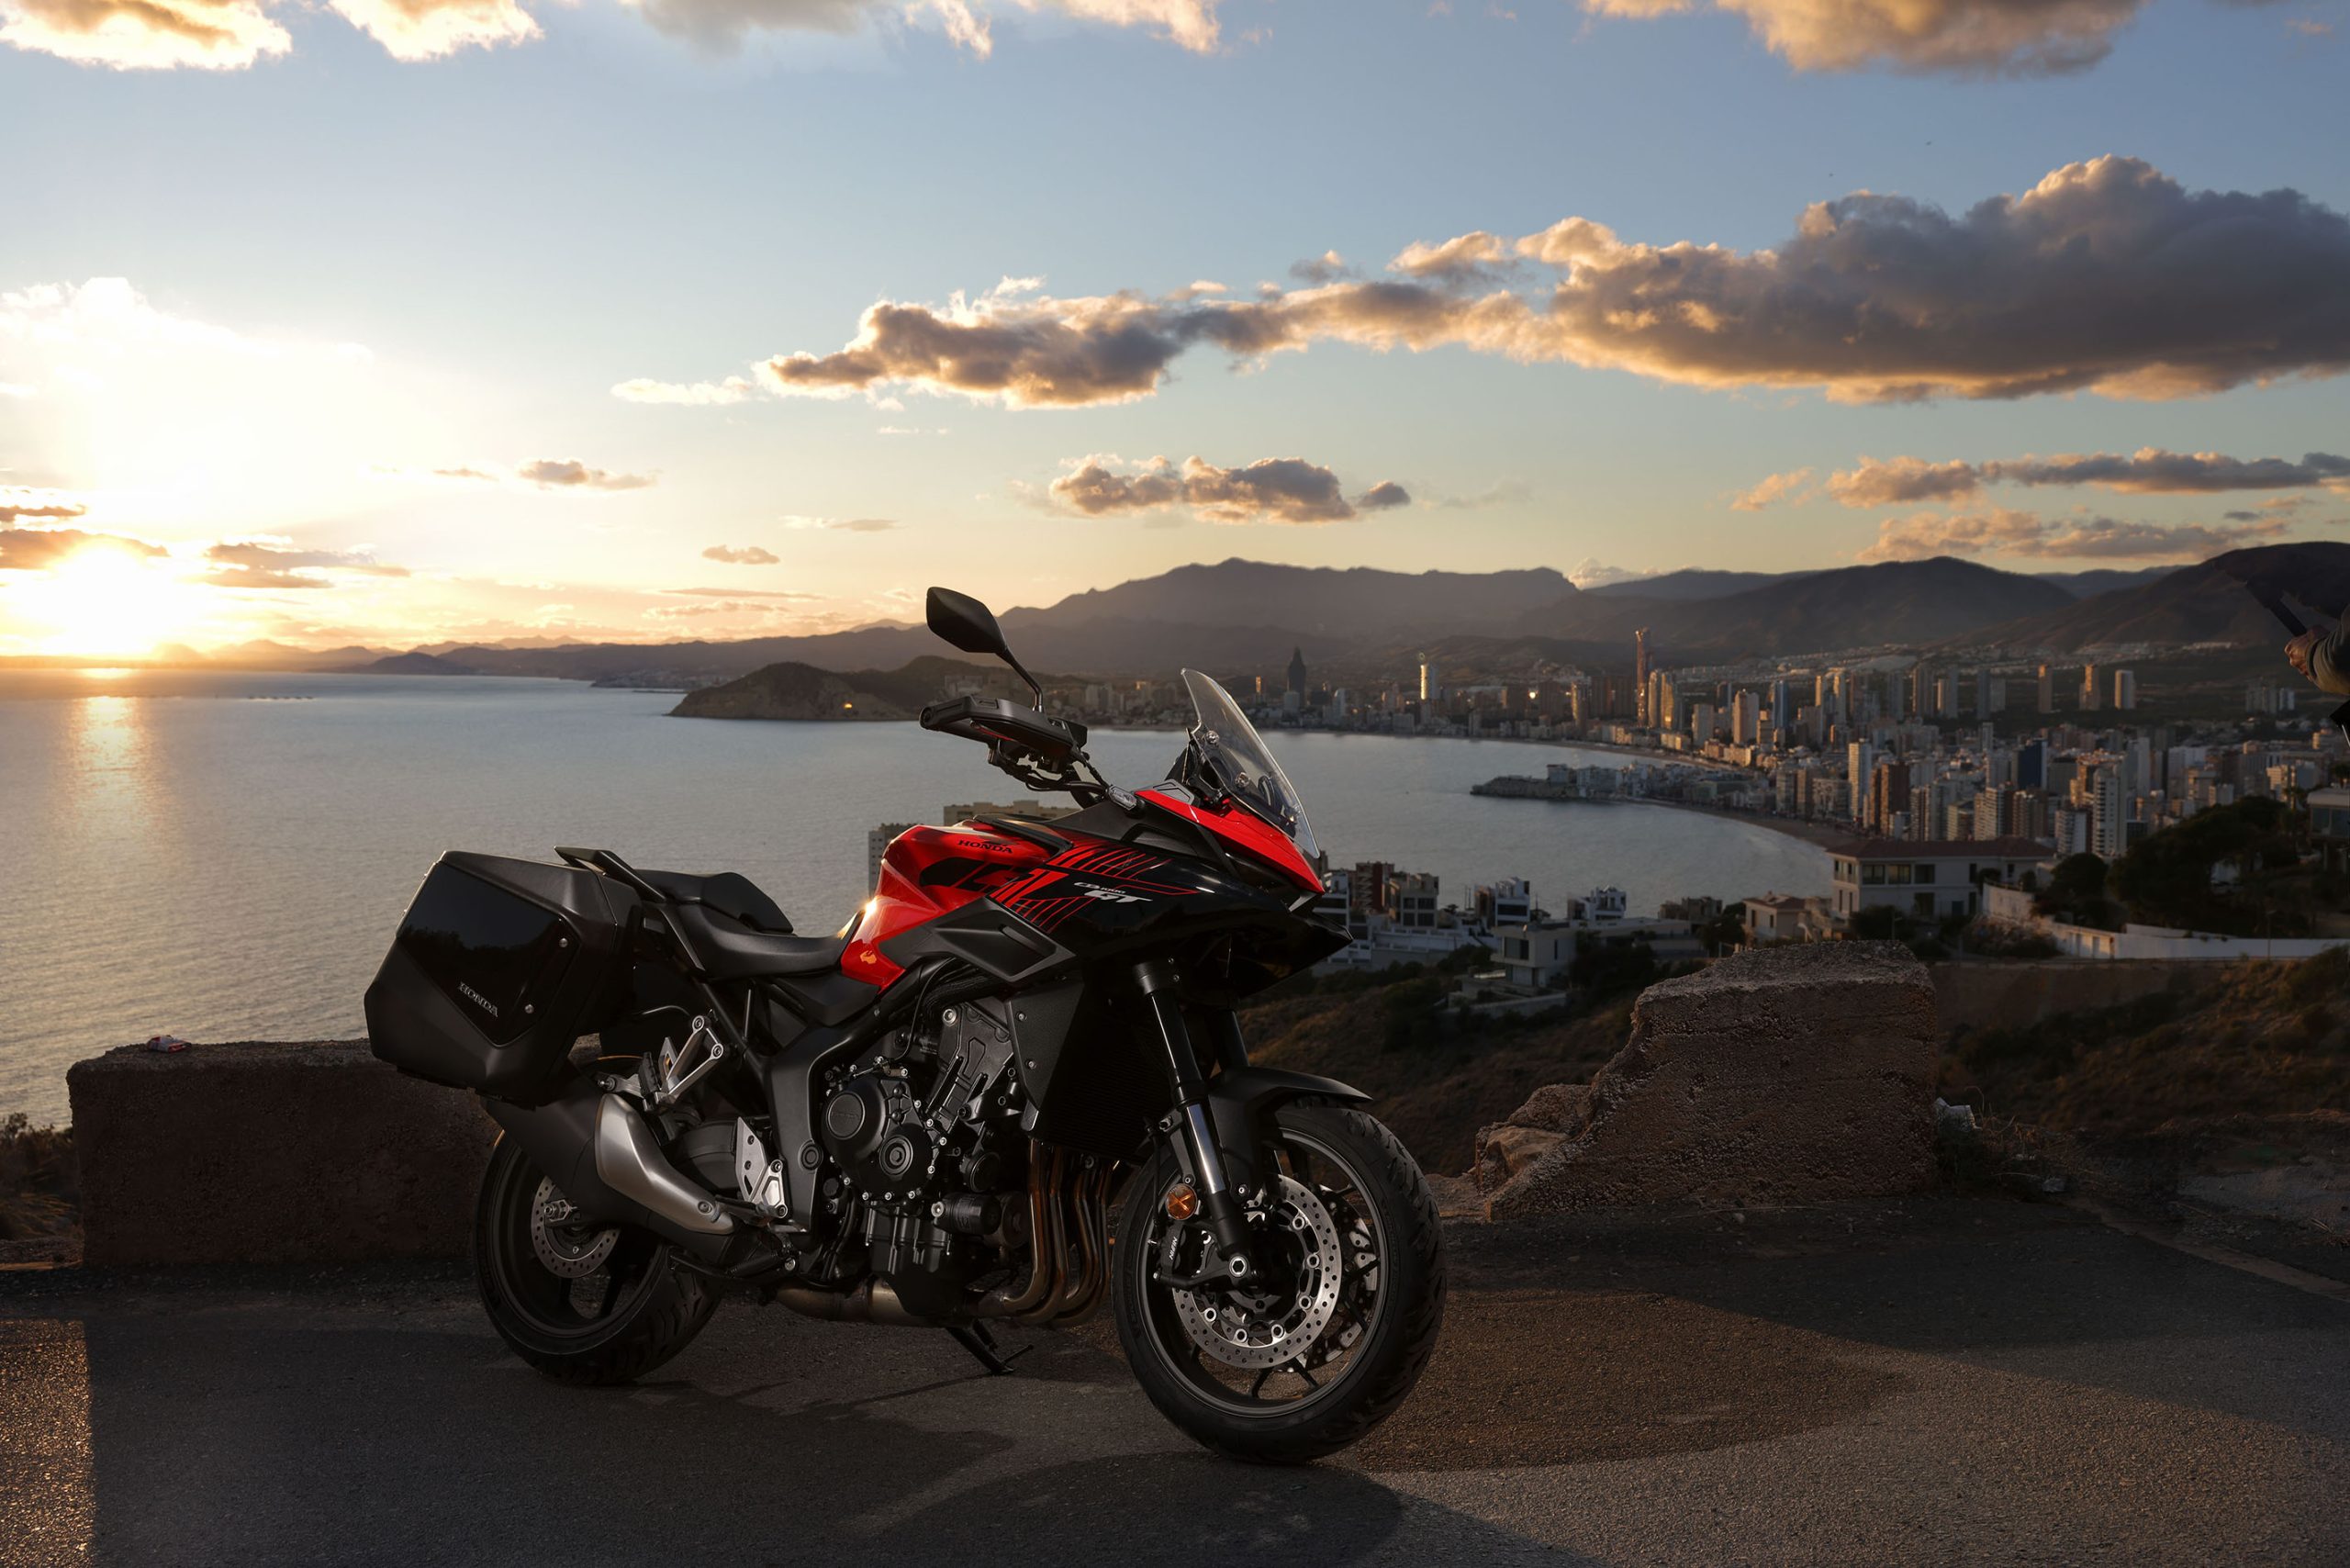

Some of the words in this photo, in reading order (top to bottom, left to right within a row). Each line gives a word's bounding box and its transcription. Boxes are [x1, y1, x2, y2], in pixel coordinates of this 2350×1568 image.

[957, 839, 1013, 854] HONDA
[1083, 890, 1154, 903] GT
[458, 980, 498, 1018] HONDA
